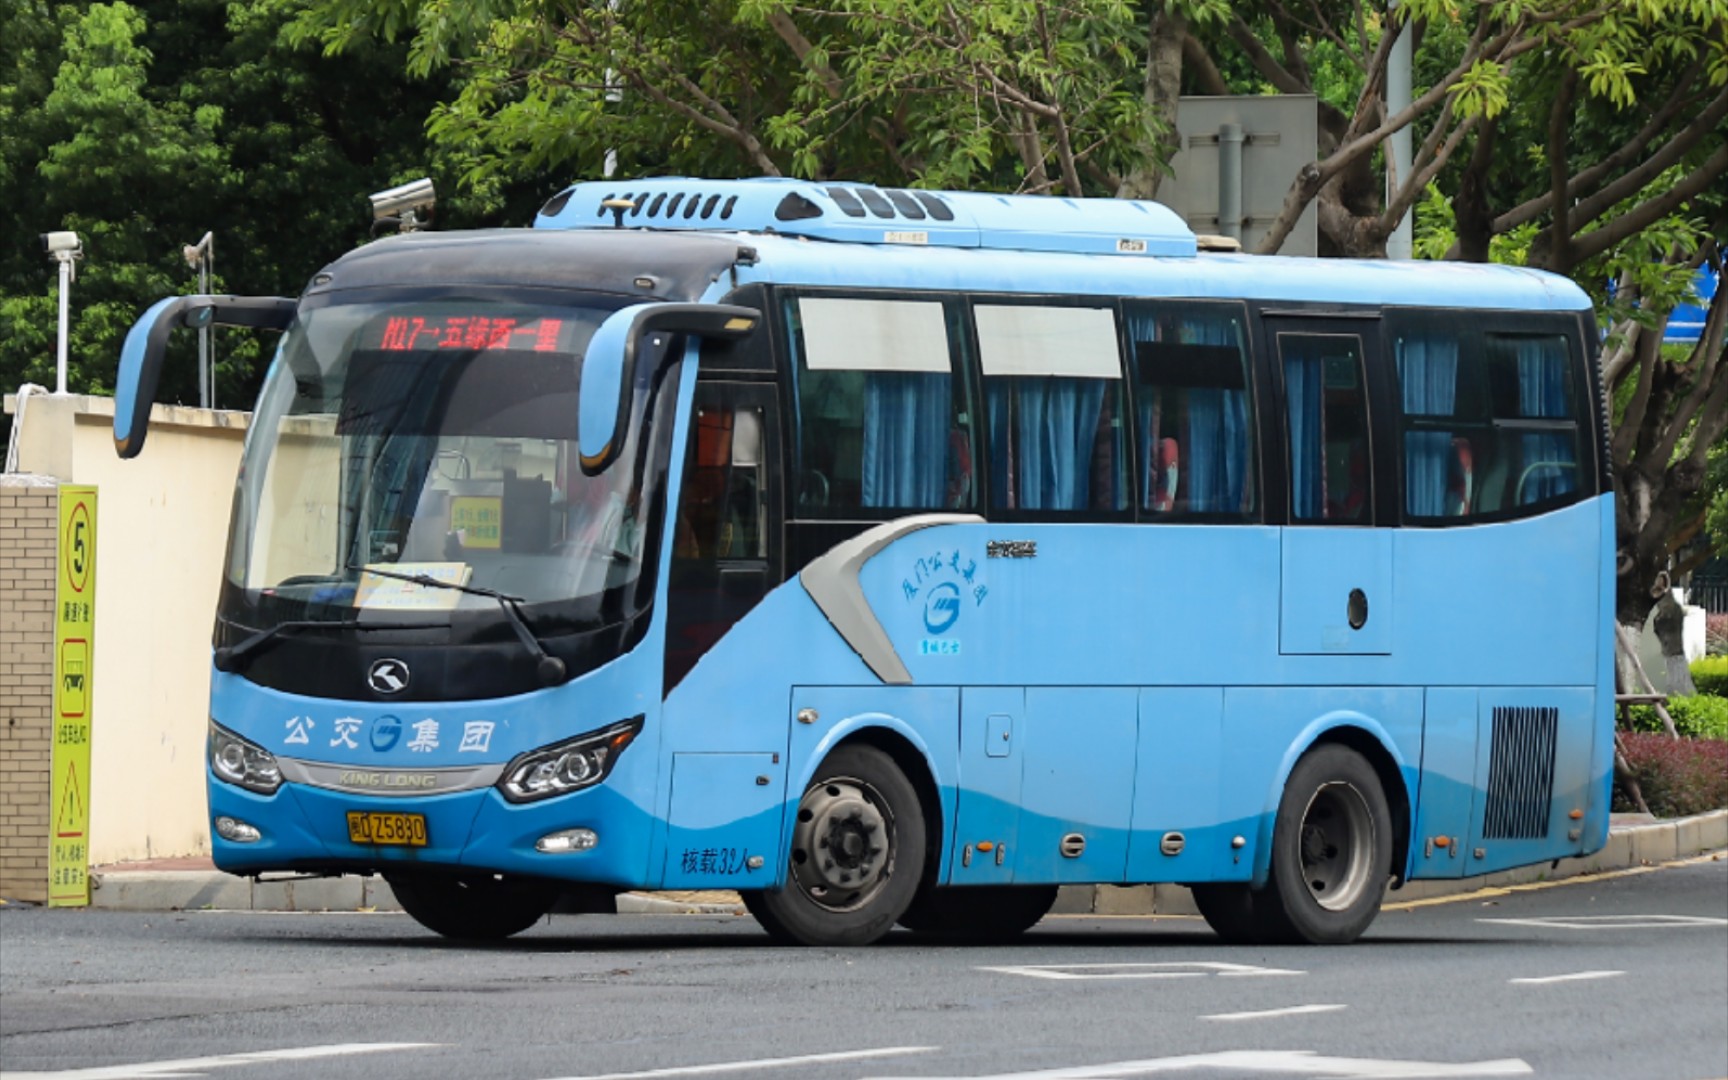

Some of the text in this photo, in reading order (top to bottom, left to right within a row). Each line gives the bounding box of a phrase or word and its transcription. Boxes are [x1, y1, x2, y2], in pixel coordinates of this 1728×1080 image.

[74, 521, 84, 573] 5
[339, 770, 437, 787] KING LONG
[681, 847, 752, 875] 核载32人
